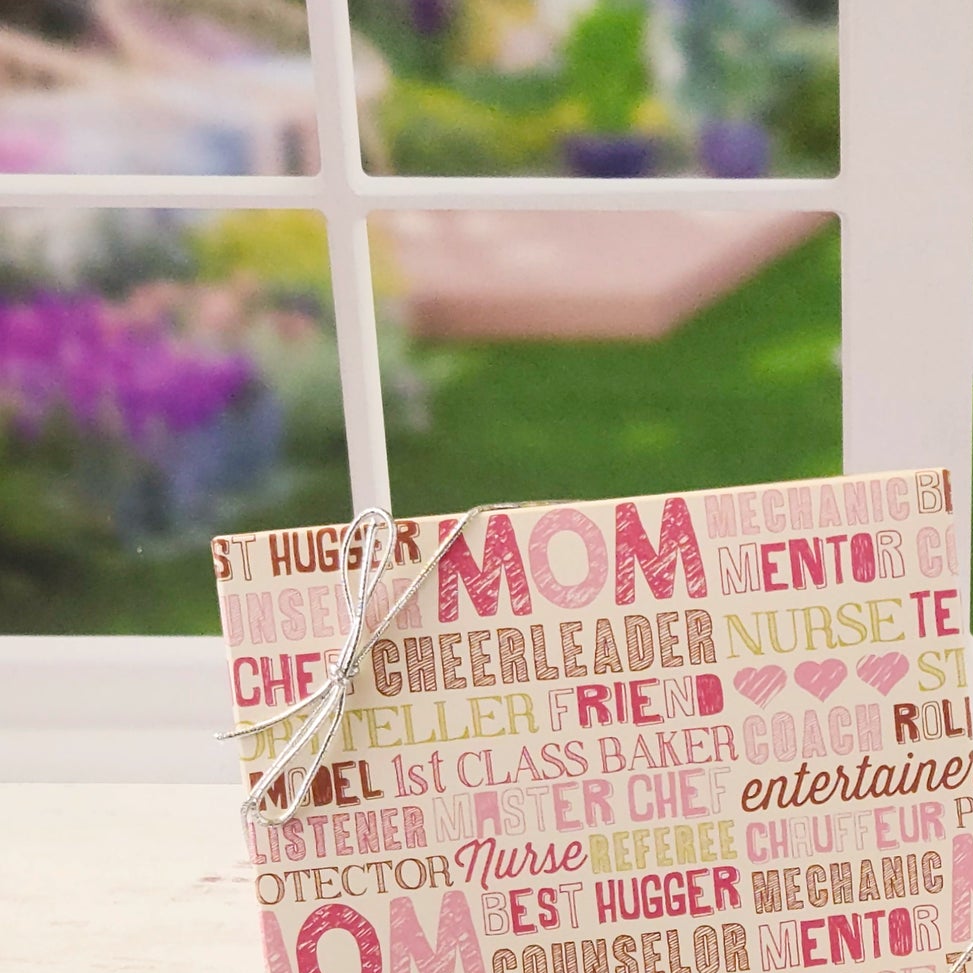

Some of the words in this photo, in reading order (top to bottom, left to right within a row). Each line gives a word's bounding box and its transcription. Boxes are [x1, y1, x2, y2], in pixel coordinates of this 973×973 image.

[704, 477, 910, 540] MECHANIC
[438, 497, 708, 623] MOM
[717, 530, 905, 595] MENTOR
[371, 609, 717, 696] CHEERLEADER
[724, 598, 905, 659] NURSE
[548, 674, 724, 731] FRIEND
[248, 760, 384, 810] MODEL
[392, 750, 446, 798] 1st
[456, 740, 590, 788] CLASS
[598, 725, 739, 775] BAKER
[743, 703, 883, 765] COACH
[249, 806, 427, 864] LISTENER
[434, 779, 616, 843] MASTER
[627, 767, 732, 822] CHEF
[255, 856, 454, 905] OTECTOR
[455, 838, 587, 890] Nurse
[589, 820, 737, 873] REFEREE
[745, 802, 946, 864] CHAUFFEUR
[483, 881, 583, 936] BEST
[595, 866, 741, 924] HUGGER
[752, 851, 944, 914] MECHANIC
[759, 904, 941, 971] MENTOR
